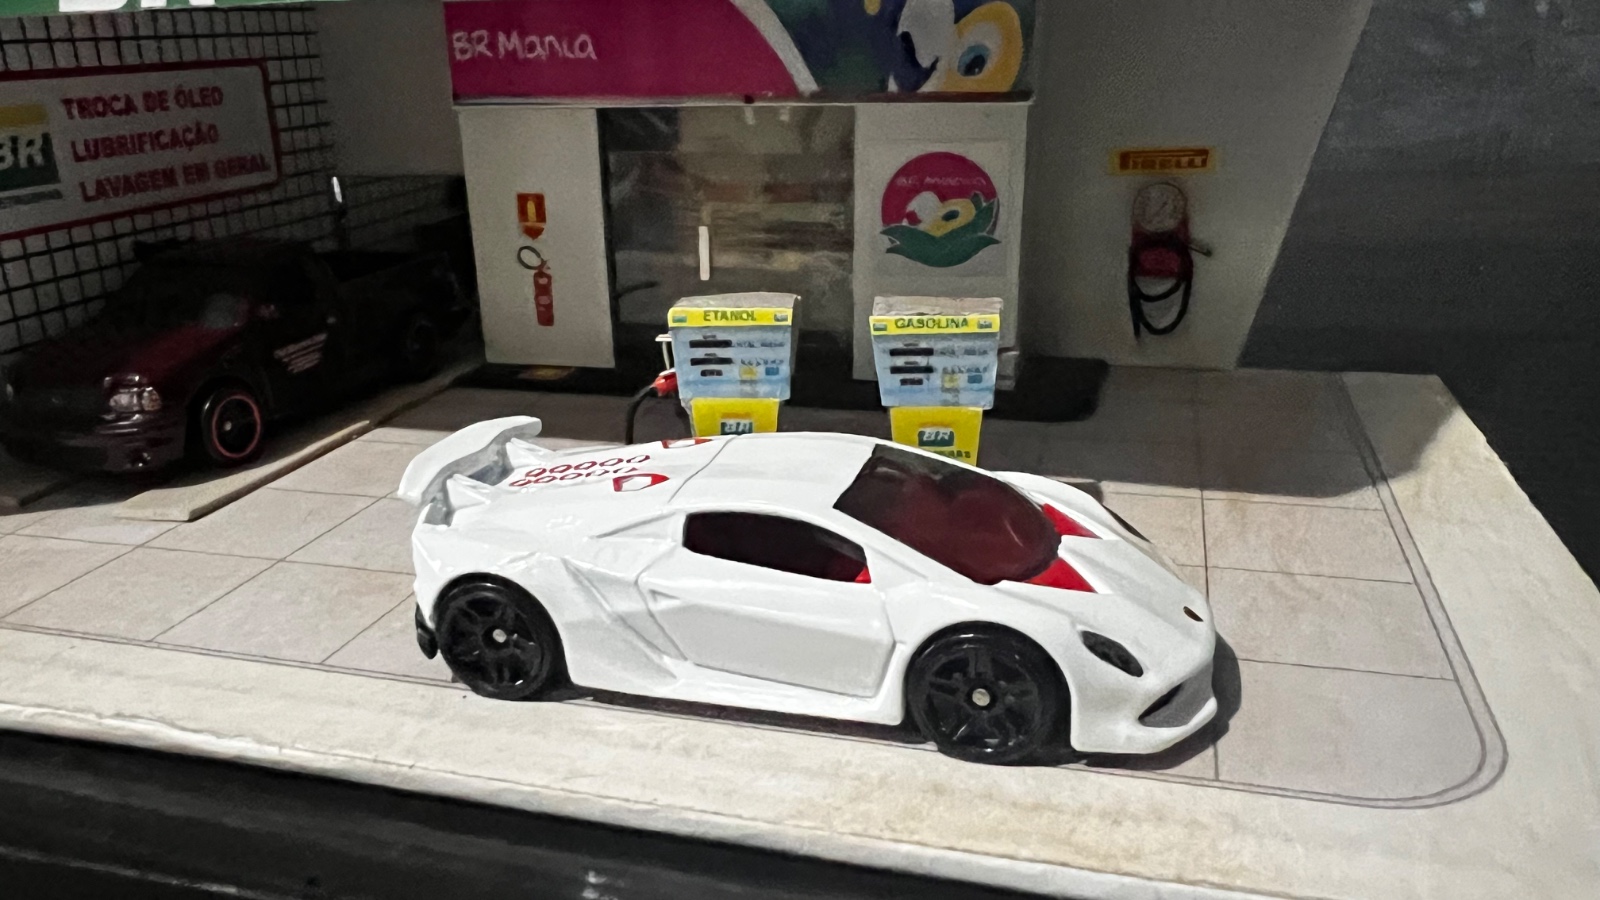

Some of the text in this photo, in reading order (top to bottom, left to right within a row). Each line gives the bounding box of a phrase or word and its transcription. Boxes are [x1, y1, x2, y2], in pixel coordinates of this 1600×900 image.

[452, 30, 493, 61] BR
[60, 84, 224, 120] TROCA DE ÓLEO
[70, 121, 220, 163] LUBRIFICAÇÃO
[213, 153, 271, 180] GERAL
[703, 309, 757, 322] ETANOL
[894, 316, 970, 330] GASOLINA
